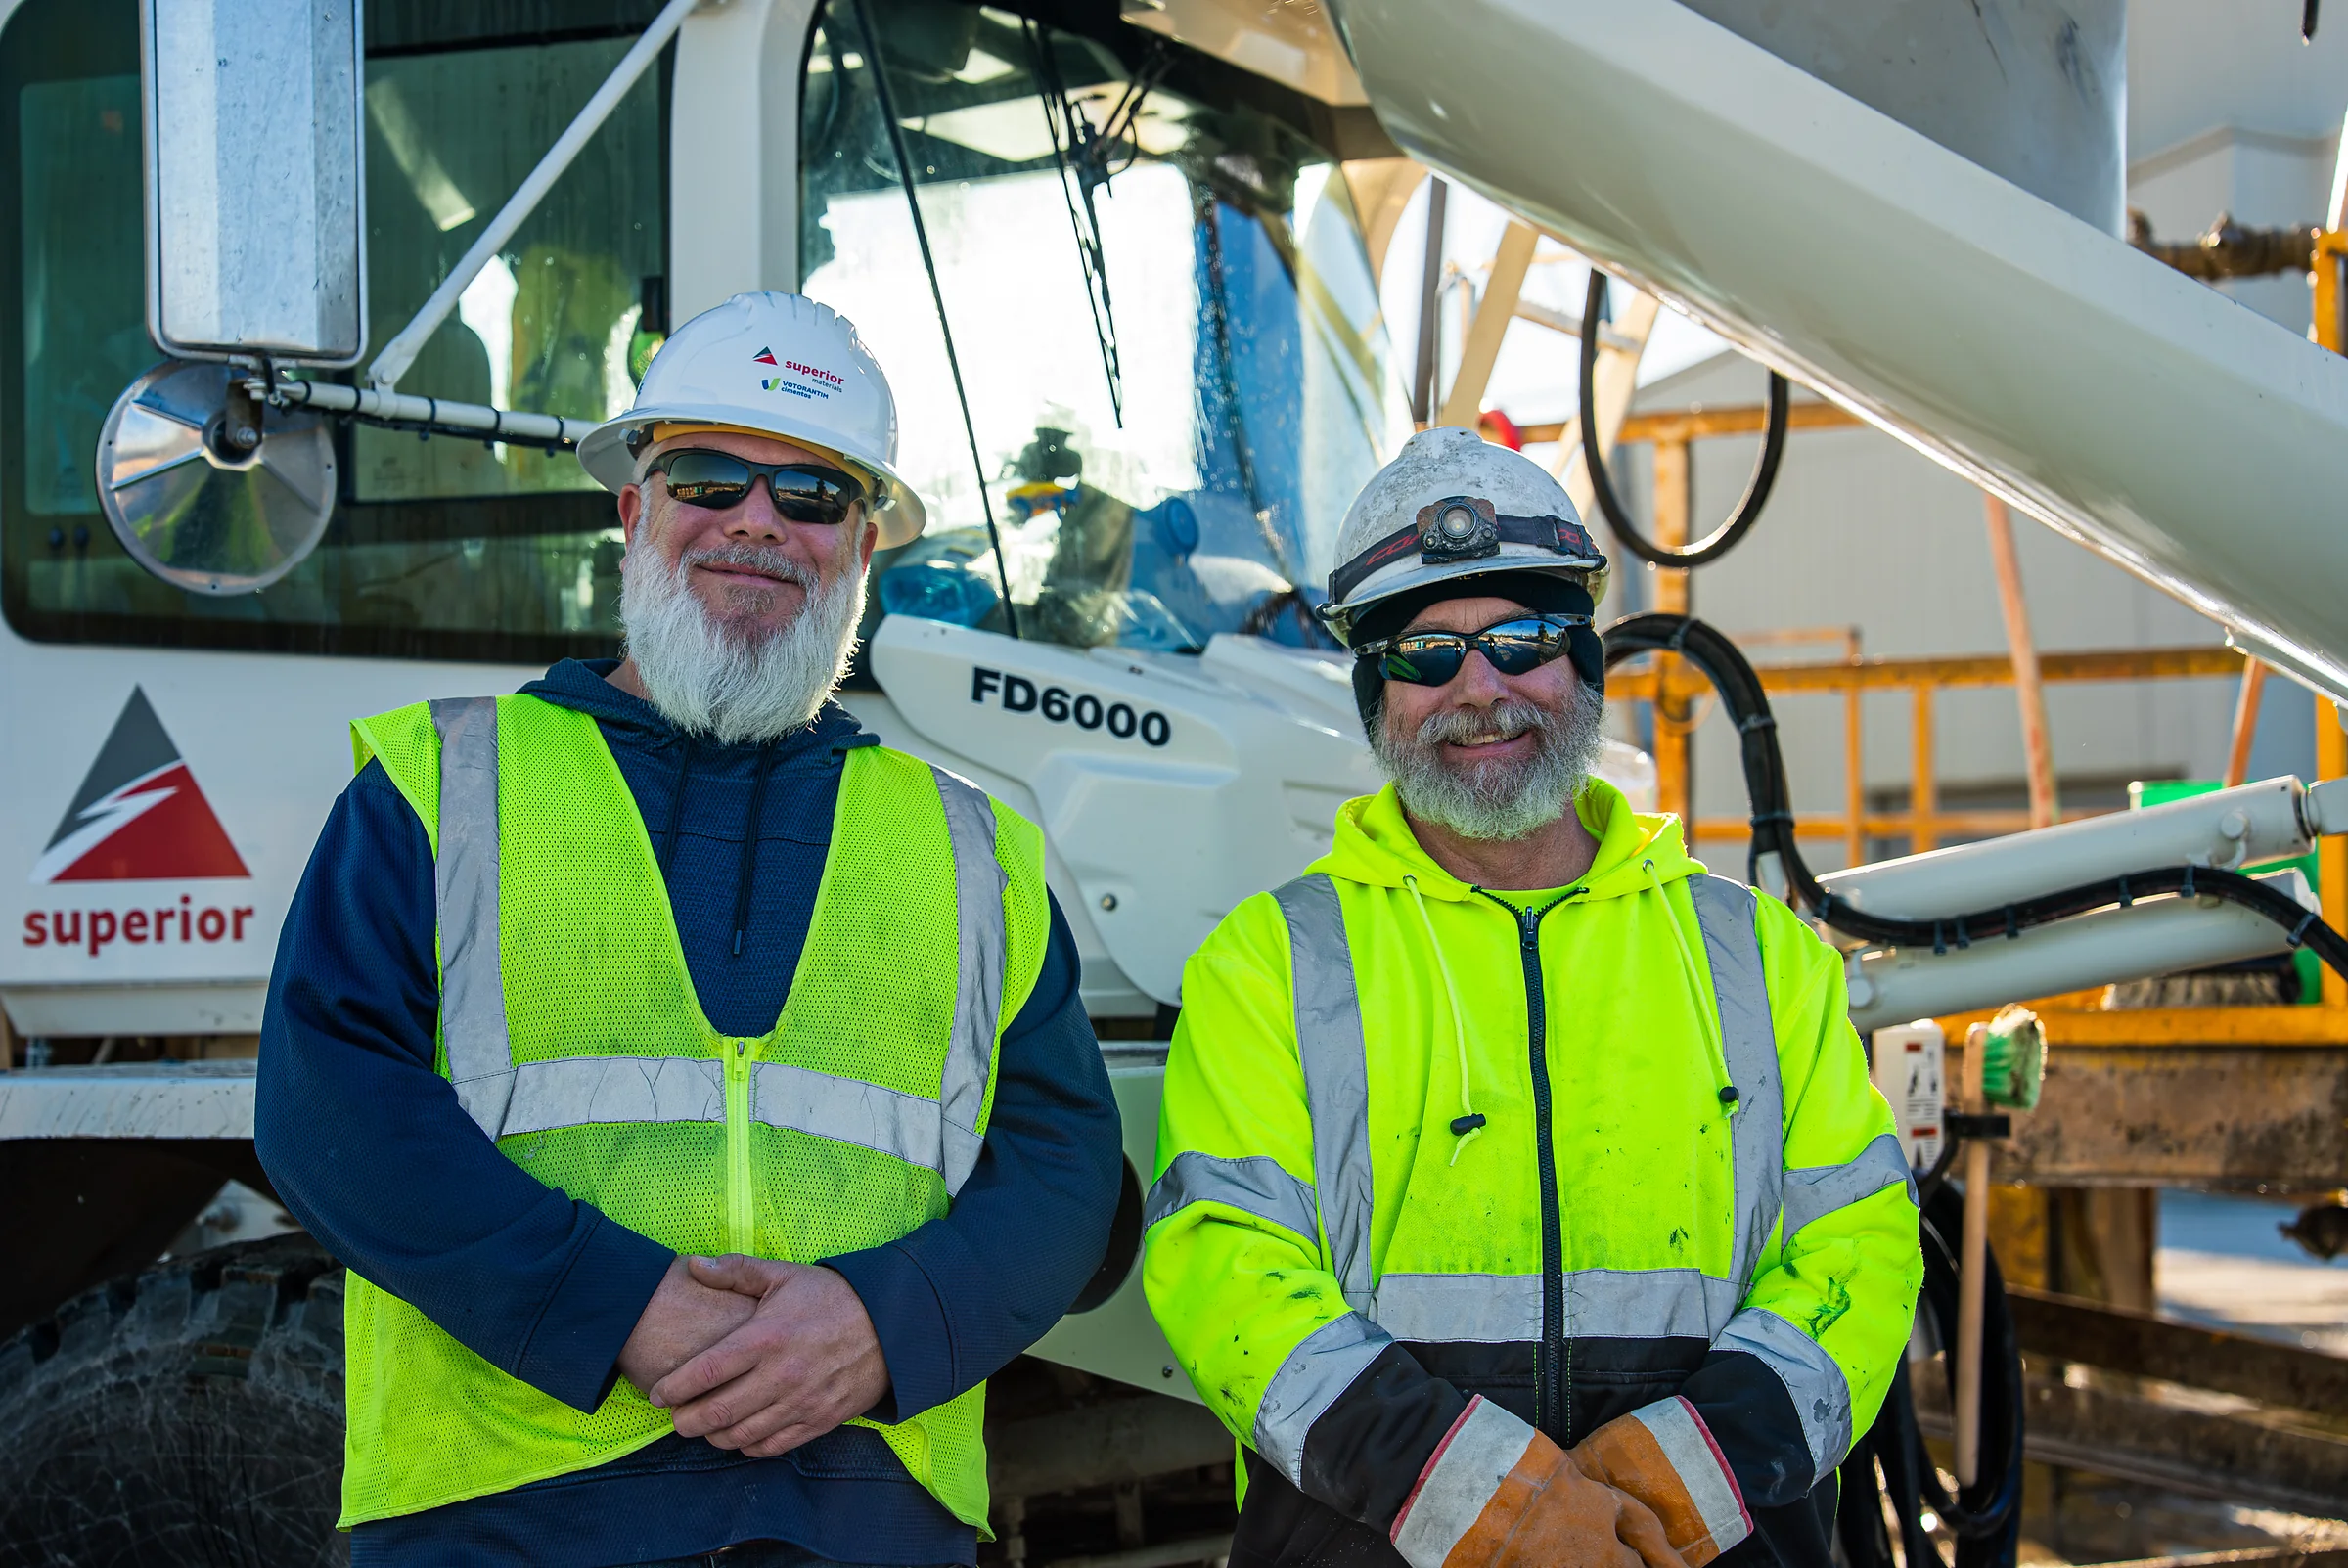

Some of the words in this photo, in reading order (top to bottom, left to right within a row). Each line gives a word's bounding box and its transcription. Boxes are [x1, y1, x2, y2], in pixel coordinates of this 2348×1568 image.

[785, 359, 845, 385] superior
[781, 386, 812, 400] cimentos
[782, 380, 829, 400] VOTORANTIM
[811, 377, 843, 393] materials
[971, 665, 1171, 746] FD6000
[23, 893, 254, 958] superior
